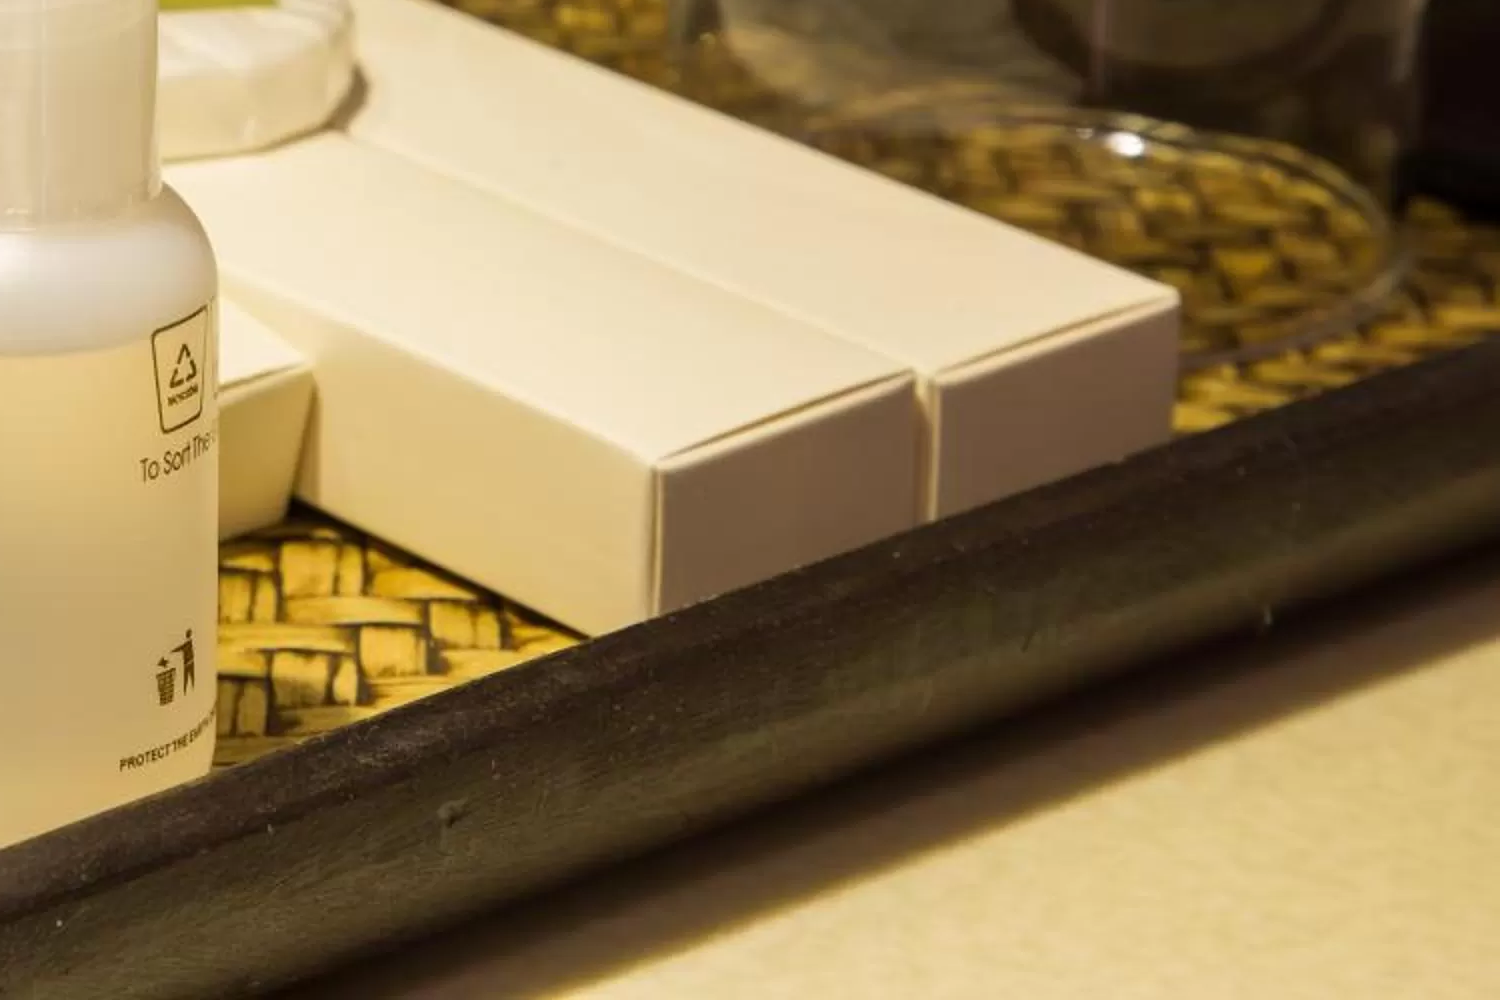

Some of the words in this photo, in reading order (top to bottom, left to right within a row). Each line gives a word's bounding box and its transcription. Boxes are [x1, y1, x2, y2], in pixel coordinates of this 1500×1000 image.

[139, 456, 161, 482] To
[162, 445, 191, 475] Sort
[119, 742, 171, 772] PROTECT
[171, 733, 189, 752] THE
